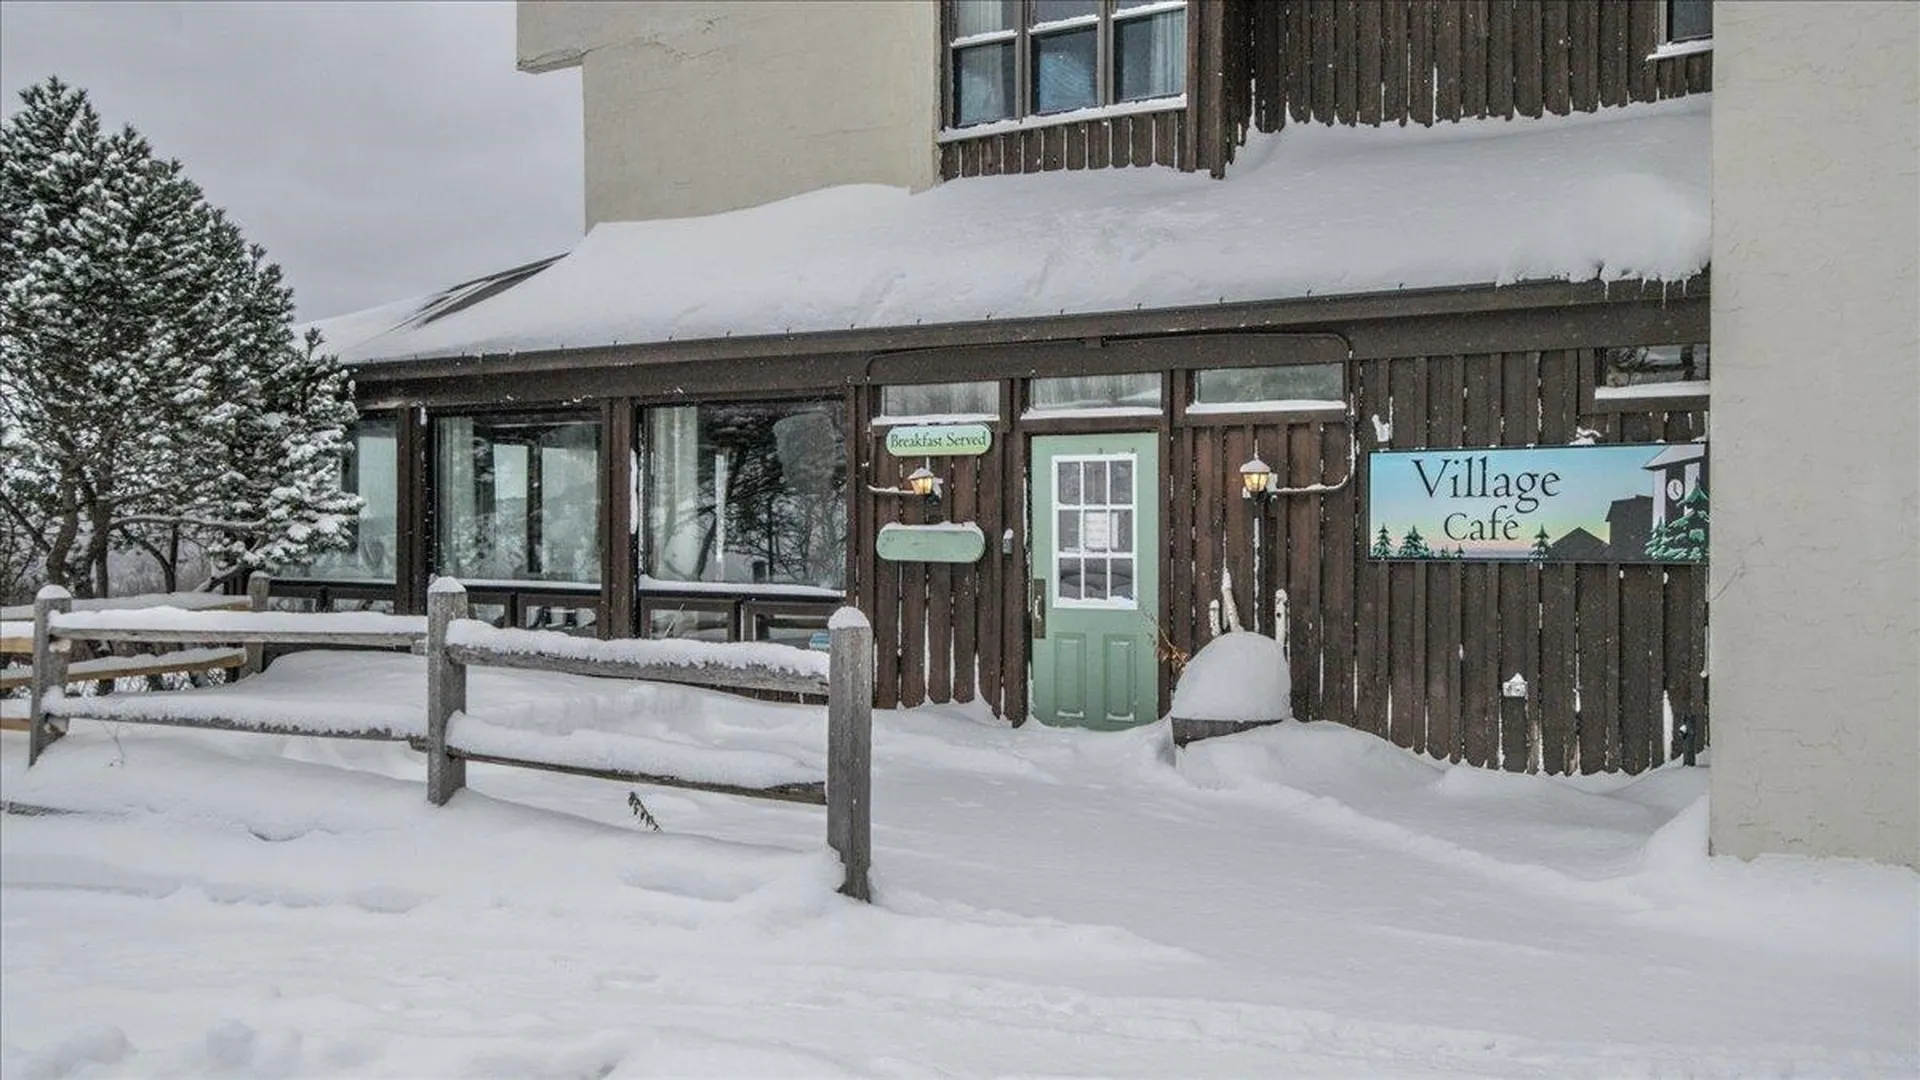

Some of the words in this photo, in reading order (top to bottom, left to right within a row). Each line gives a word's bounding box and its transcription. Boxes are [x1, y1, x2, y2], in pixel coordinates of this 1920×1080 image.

[890, 432, 942, 448] Breakfast
[946, 431, 986, 447] Served
[1412, 456, 1561, 513] Village
[1443, 505, 1519, 541] Café
